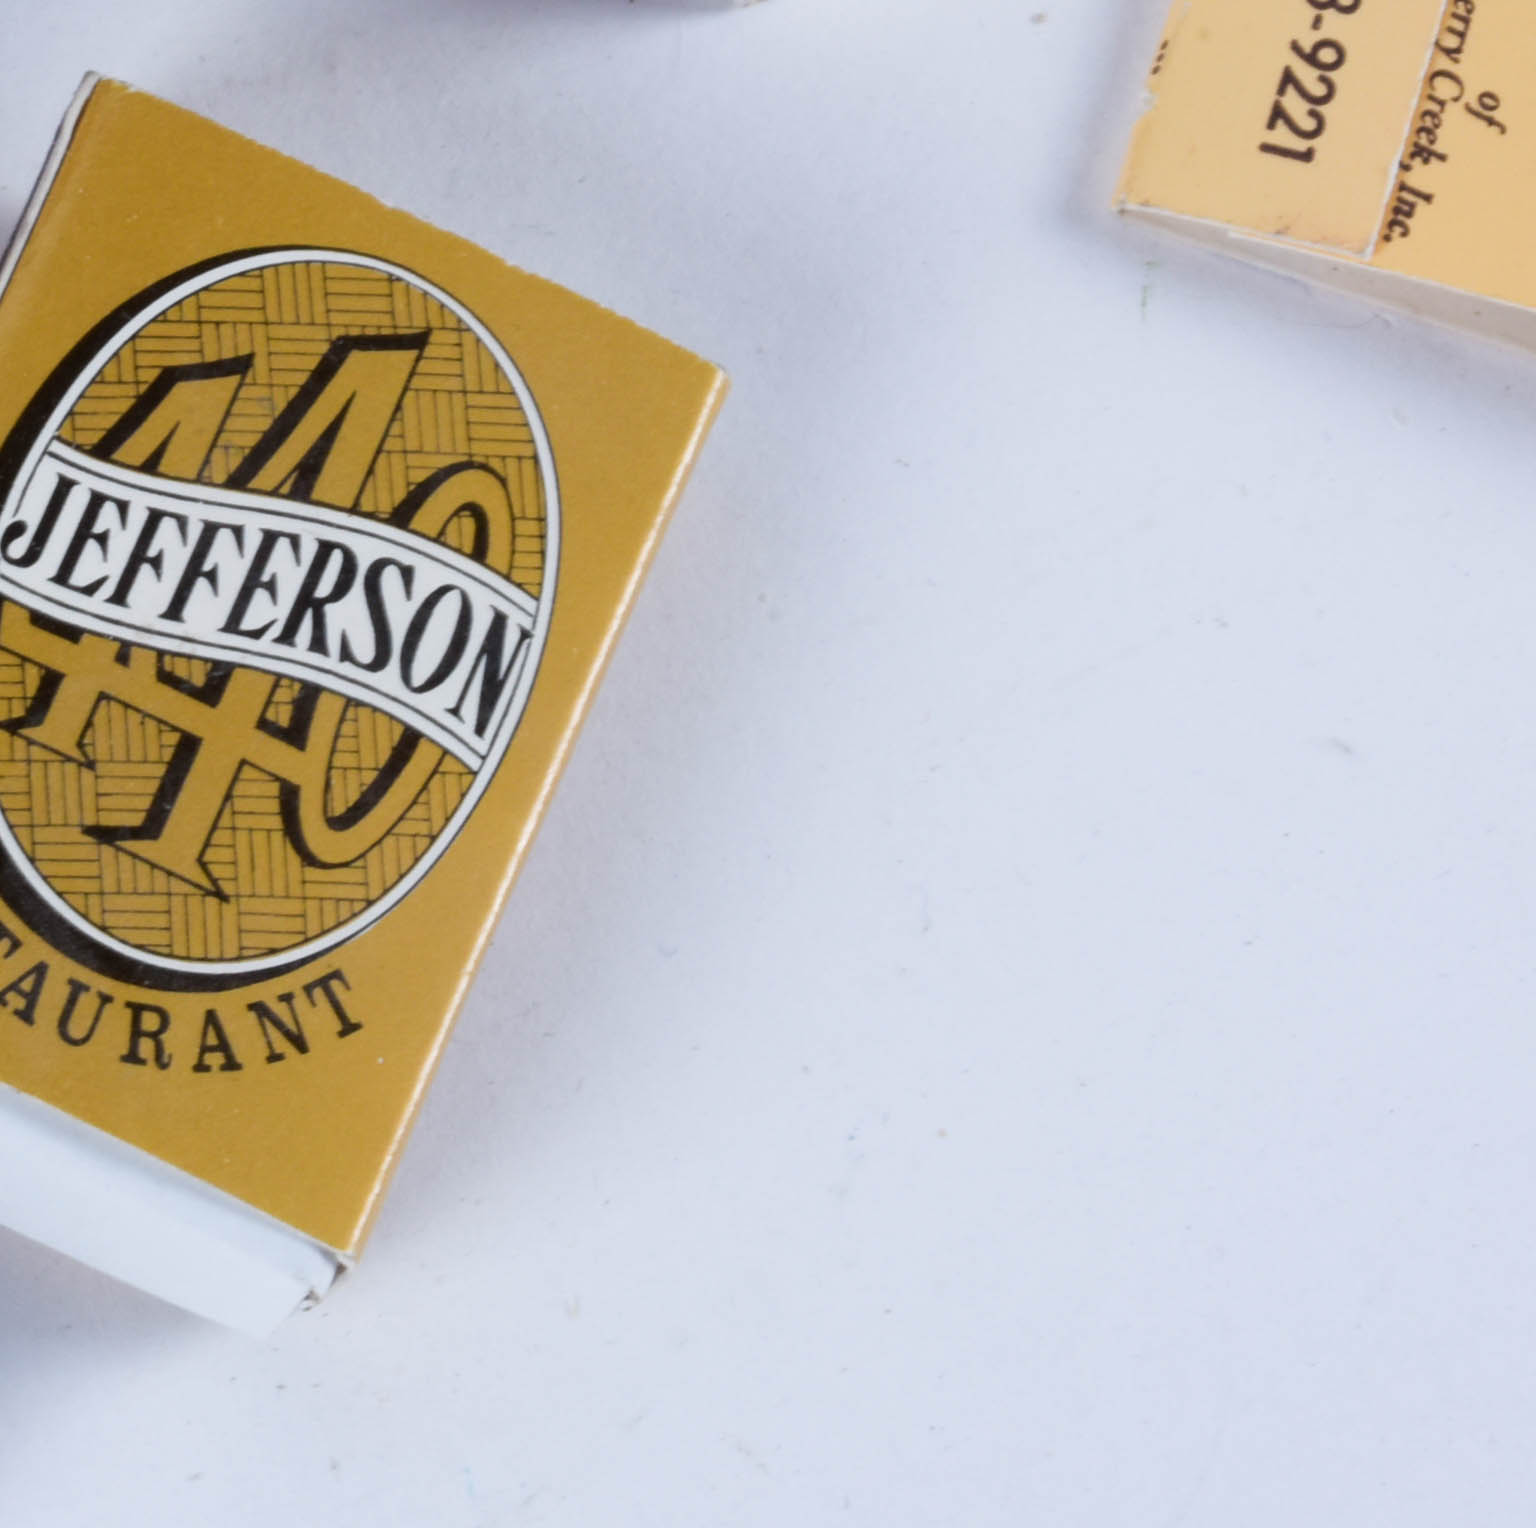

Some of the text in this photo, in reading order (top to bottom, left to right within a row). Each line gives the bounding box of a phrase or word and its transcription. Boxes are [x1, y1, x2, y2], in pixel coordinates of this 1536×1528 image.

[1398, 68, 1466, 173] Creek,
[1464, 90, 1508, 136] of
[1381, 179, 1436, 244] Inc.
[0, 471, 533, 742] JEFFERSON
